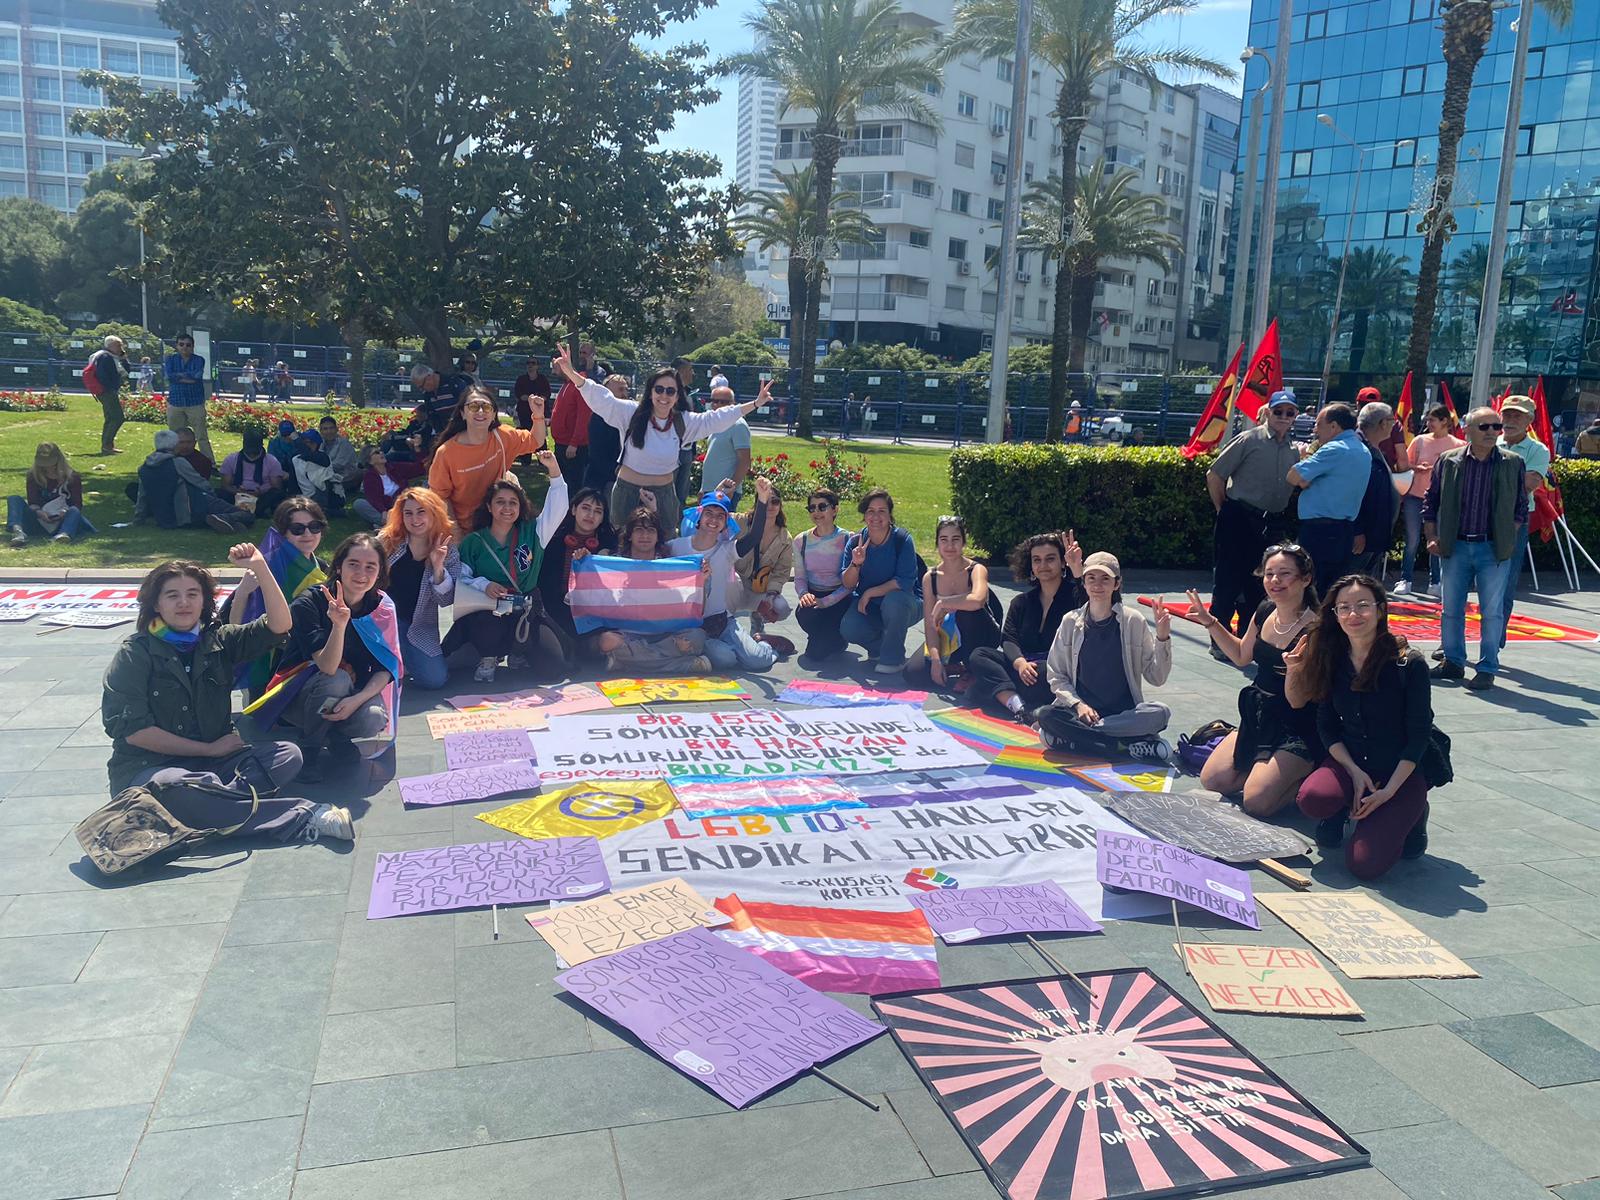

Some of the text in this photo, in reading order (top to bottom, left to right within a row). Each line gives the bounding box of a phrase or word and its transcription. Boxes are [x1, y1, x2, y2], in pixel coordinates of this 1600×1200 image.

[754, 734, 907, 751] HAYVAN
[891, 800, 1083, 830] HAKLARI
[617, 885, 688, 910] EMEK
[1185, 946, 1321, 969] NE EZEN
[592, 950, 737, 1015] PATRON DA
[767, 976, 807, 1000] DE
[1203, 982, 1248, 1005] NE
[706, 999, 828, 1058] SEN DE
[1077, 1076, 1254, 1111] BAZI HAYVANLAR
[1106, 1077, 1152, 1090] AMA
[1100, 1125, 1160, 1145] DAHA
